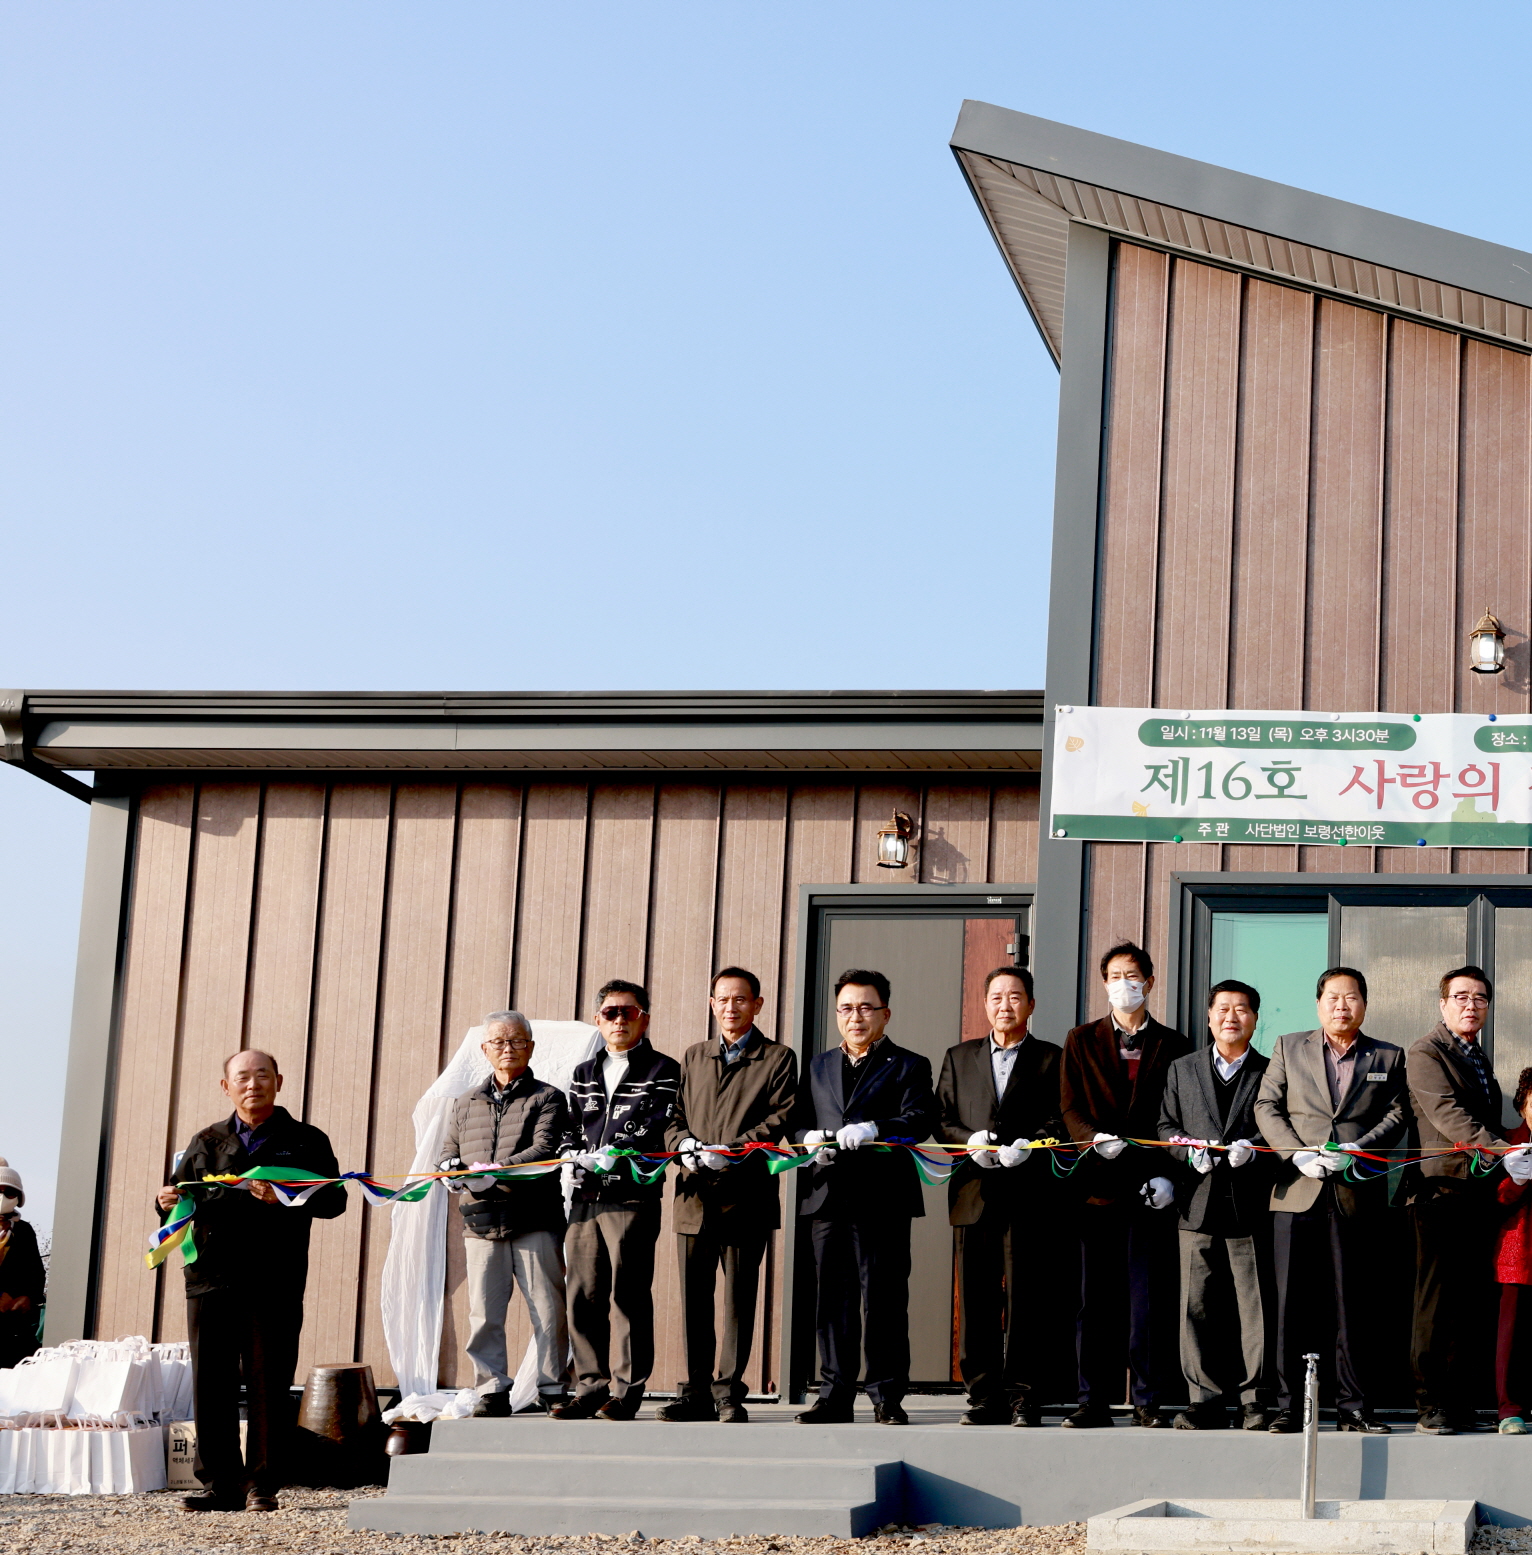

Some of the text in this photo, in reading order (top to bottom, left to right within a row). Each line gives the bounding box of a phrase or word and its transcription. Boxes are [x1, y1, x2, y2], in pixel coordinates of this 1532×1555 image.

[1199, 726, 1226, 741] 11월
[1230, 727, 1261, 742] 13일
[1268, 727, 1293, 742] (목)
[1300, 727, 1329, 742] 오후
[1332, 728, 1390, 743] 3시30분
[1140, 756, 1308, 806] 제16호
[1338, 759, 1500, 812] 사랑의
[1245, 823, 1300, 838] 사단법인
[1303, 824, 1386, 840] 보령선한이웃
[172, 1437, 197, 1456] 퍼
